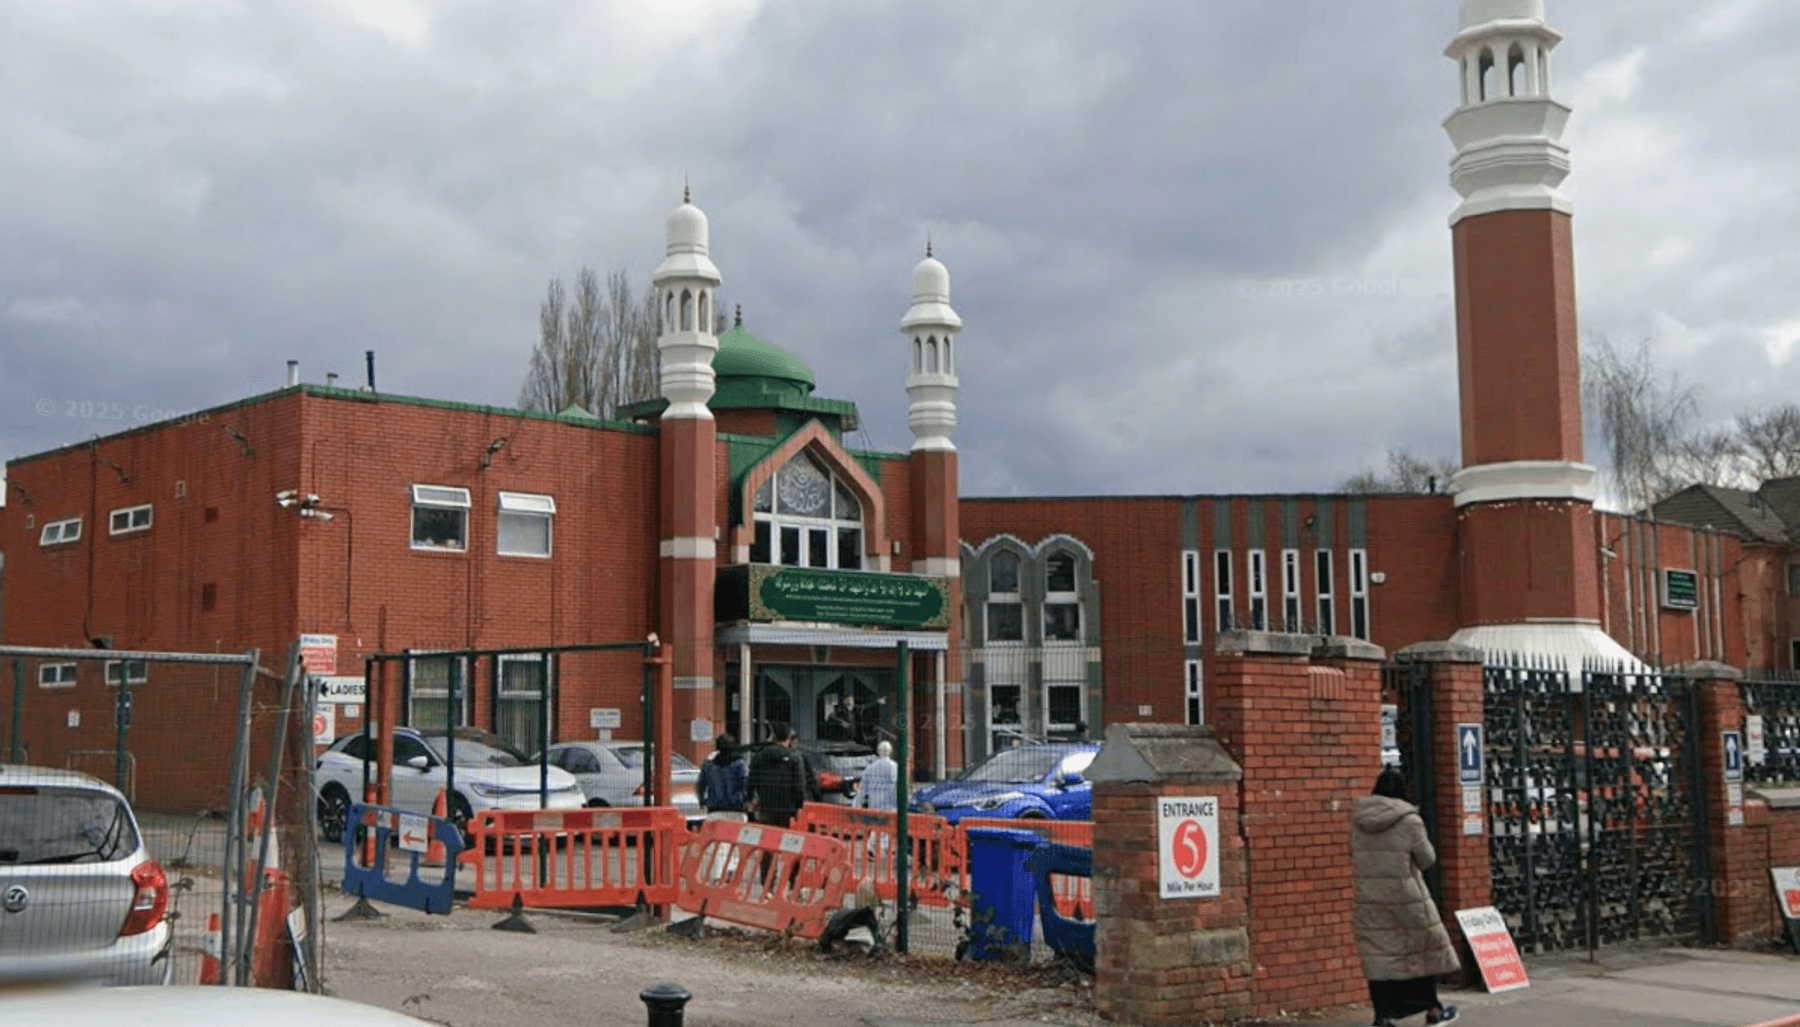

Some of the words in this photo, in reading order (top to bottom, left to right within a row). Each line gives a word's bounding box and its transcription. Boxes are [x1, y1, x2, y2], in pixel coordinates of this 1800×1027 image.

[330, 684, 366, 695] LADIES
[1163, 802, 1214, 817] ENTRANCE
[1181, 824, 1200, 874] 5
